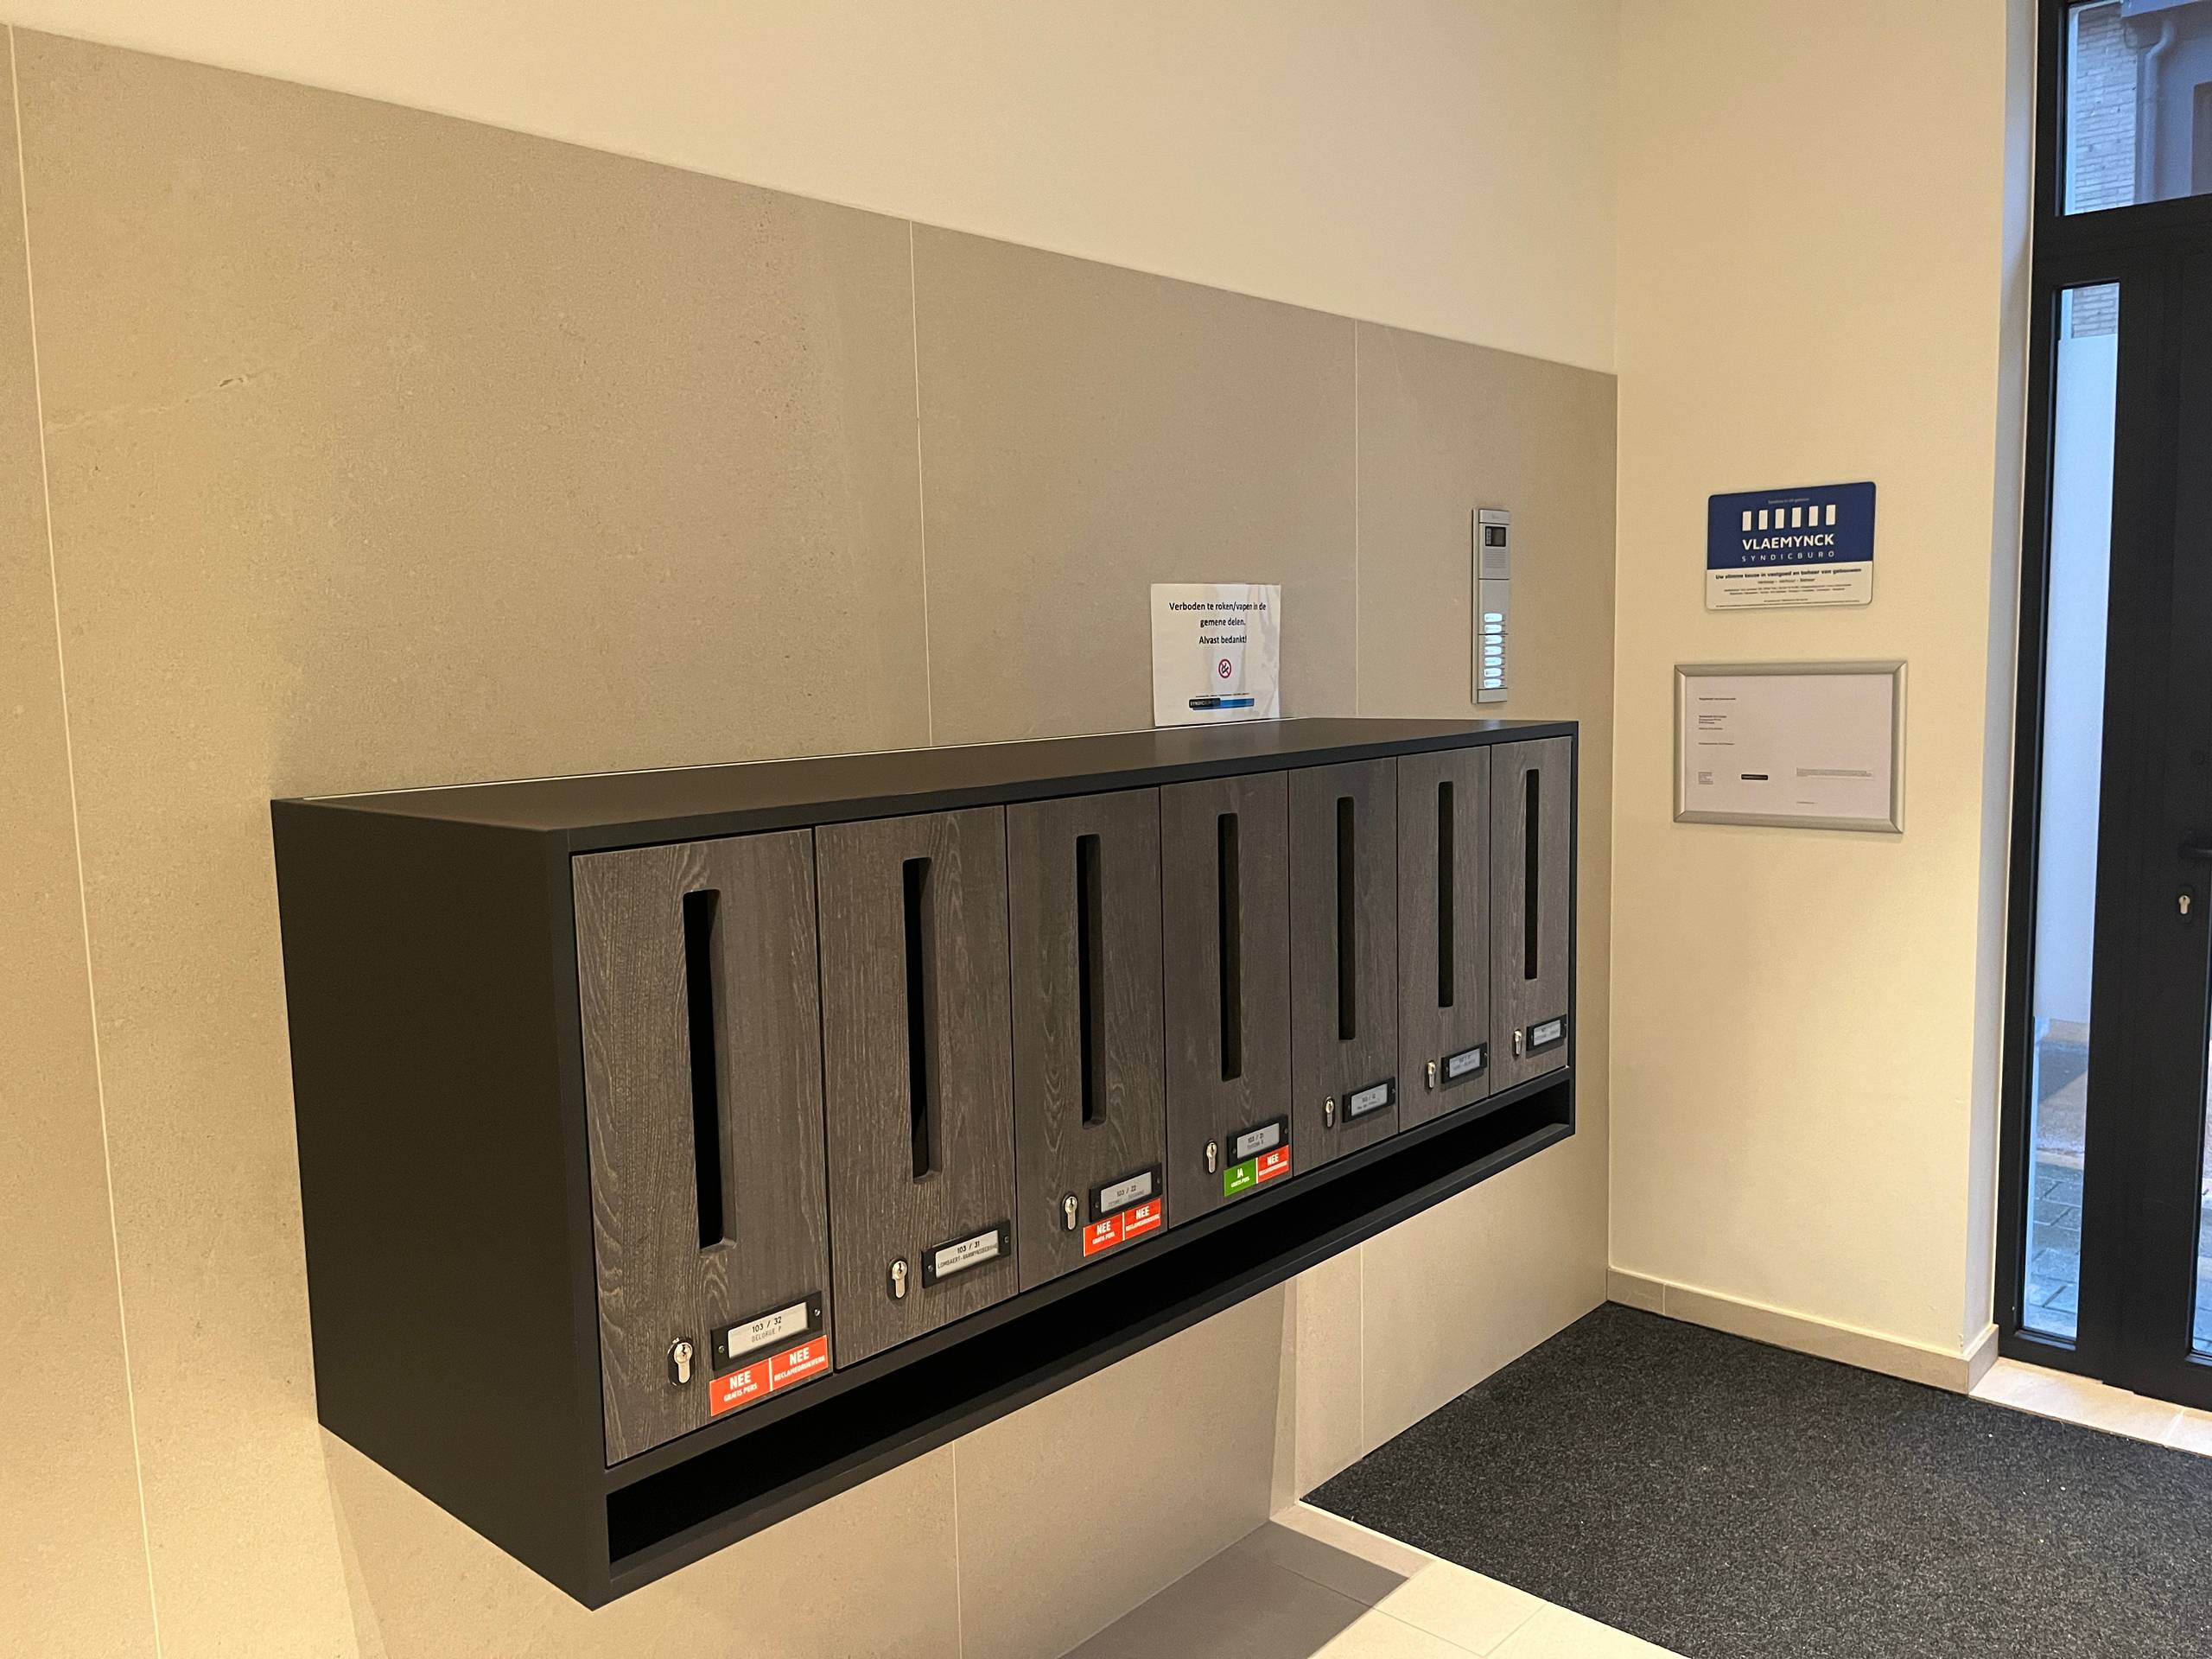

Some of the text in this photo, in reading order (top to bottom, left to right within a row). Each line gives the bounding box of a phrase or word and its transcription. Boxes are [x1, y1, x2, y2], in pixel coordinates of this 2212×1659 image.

[1742, 534, 1834, 550] VLAEMYNCK
[1741, 550, 1834, 563] SYNDICBURO
[1169, 602, 1205, 611] Verboden
[1215, 601, 1253, 612] roken/vapen
[1259, 602, 1267, 611] de
[1200, 618, 1246, 628] gemene delen.
[1199, 635, 1247, 645] Alvast bedankt!
[1267, 1153, 1279, 1166] NEE
[1236, 1167, 1244, 1179] JA
[1135, 1205, 1150, 1220] NEE
[1096, 1220, 1111, 1236] NEE
[957, 1245, 967, 1254] 103
[975, 1240, 980, 1249] 31
[752, 1315, 782, 1333] 103 / 32
[789, 1346, 810, 1366] NEE
[729, 1370, 751, 1390] NEE
[723, 1382, 758, 1402] GRATIS PERS
